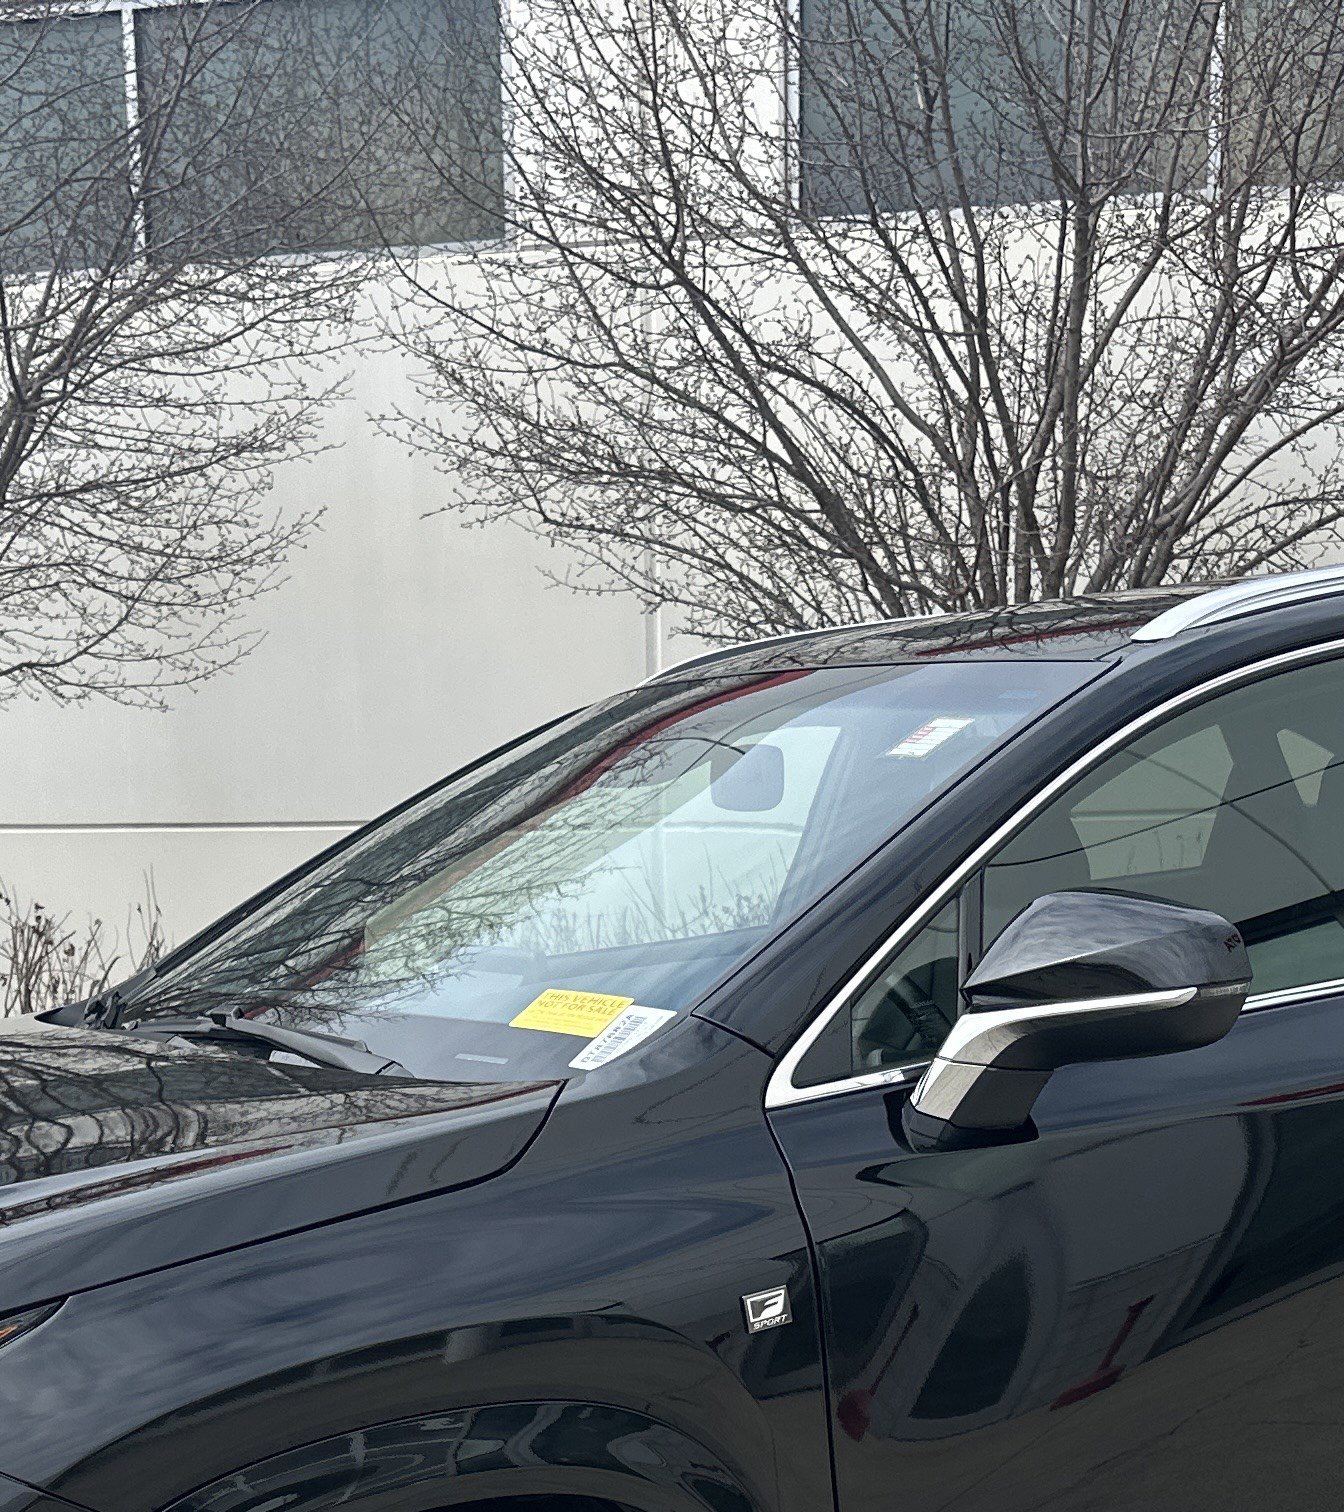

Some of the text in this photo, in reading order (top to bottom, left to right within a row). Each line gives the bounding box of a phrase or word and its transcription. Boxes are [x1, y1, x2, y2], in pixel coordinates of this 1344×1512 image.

[537, 1000, 559, 1009] NOT
[561, 1002, 584, 1011] FOR
[587, 1005, 618, 1016] SALE
[545, 992, 626, 1009] THIS VEHICLE
[753, 1313, 788, 1330] SPORT
